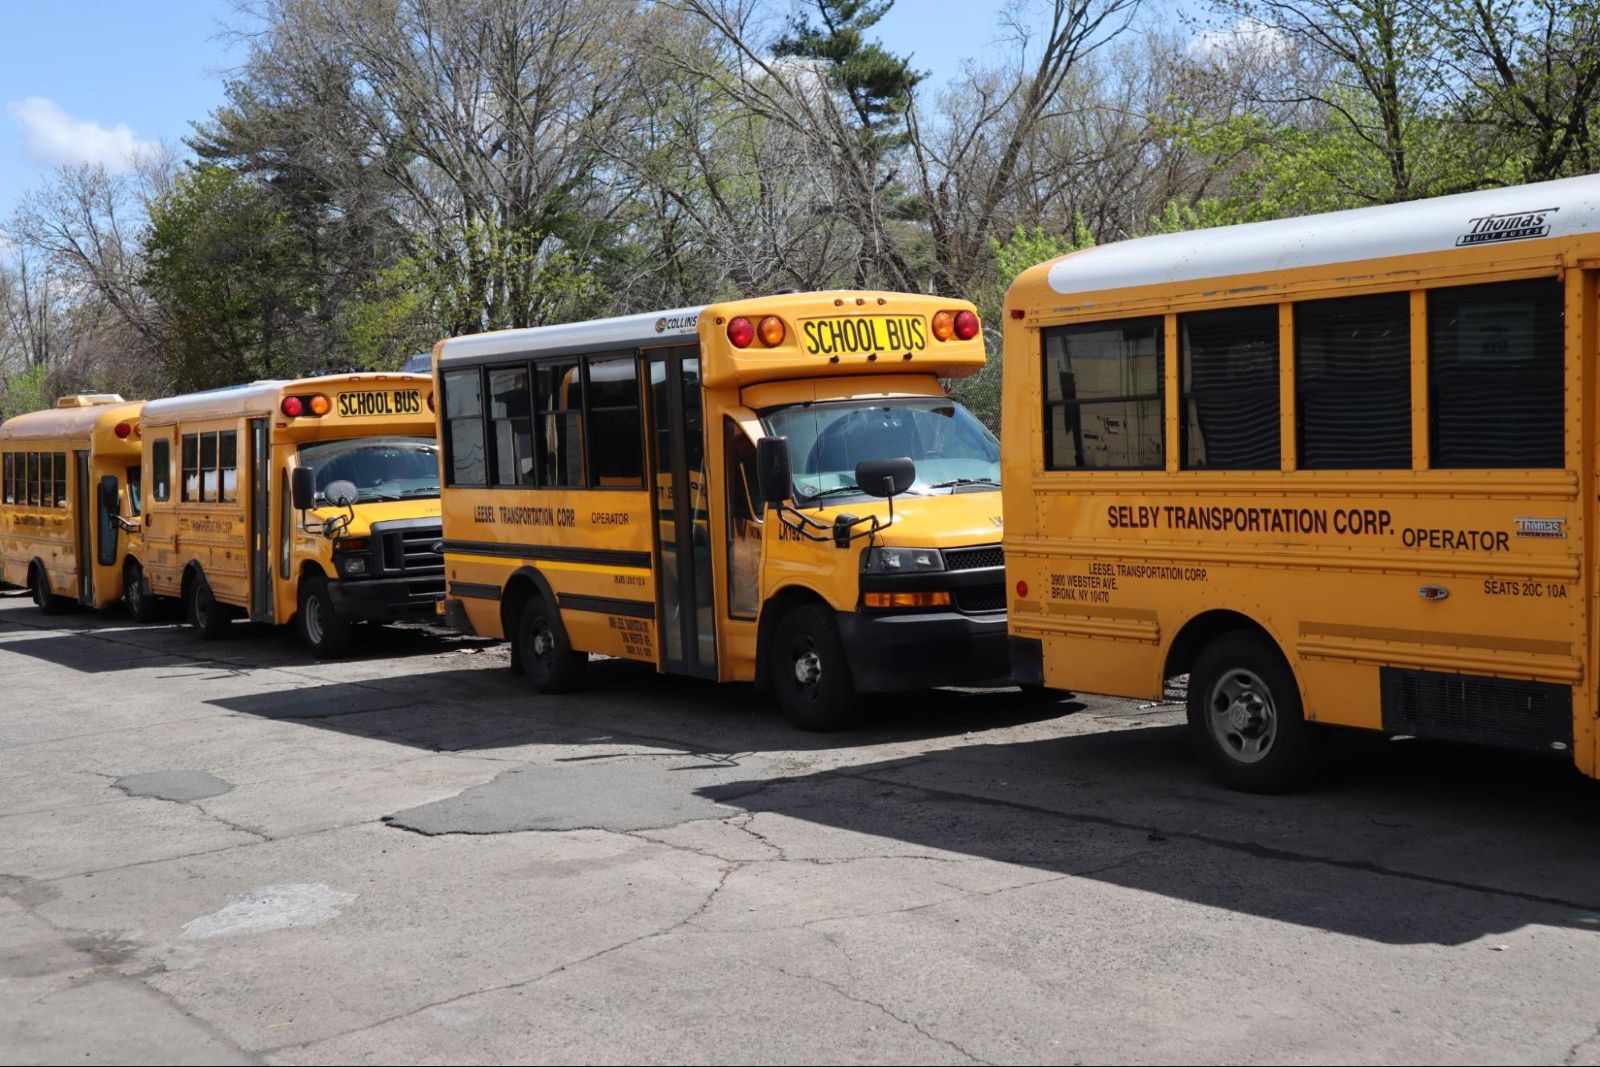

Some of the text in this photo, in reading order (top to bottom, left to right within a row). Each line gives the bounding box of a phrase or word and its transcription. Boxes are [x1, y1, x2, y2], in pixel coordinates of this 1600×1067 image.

[1468, 209, 1554, 233] Thomas
[1501, 228, 1540, 238] BUSES
[666, 316, 698, 330] COLLINS
[804, 317, 926, 355] SCHOOL BUS
[340, 391, 420, 415] SCHOOL BUS
[474, 505, 576, 527] LEESEL TRANSPORTATION CORP.
[592, 511, 629, 525] OPERATOR
[1107, 506, 1395, 535] SELBY TRANSPORTATION CORP.
[1516, 518, 1562, 532] Thomas
[1402, 528, 1510, 551] OPERATOR
[1089, 563, 1208, 582] LEESEL TRANSPORTATION CORP.
[1067, 575, 1101, 589] WEBSTER
[1102, 577, 1118, 590] AVE.
[1484, 580, 1567, 598] SEATS 20C 10A
[1078, 590, 1088, 601] NY
